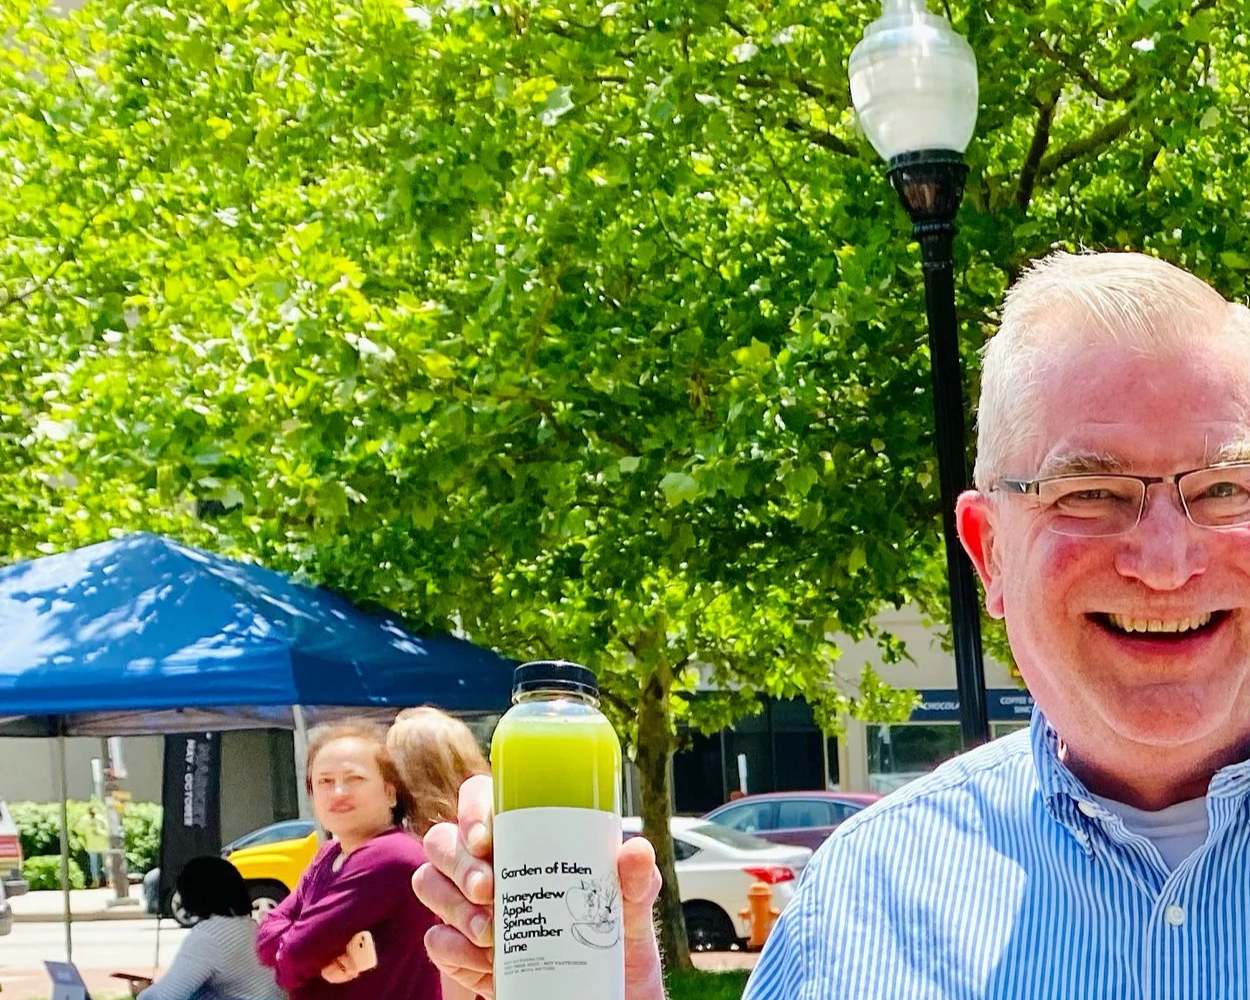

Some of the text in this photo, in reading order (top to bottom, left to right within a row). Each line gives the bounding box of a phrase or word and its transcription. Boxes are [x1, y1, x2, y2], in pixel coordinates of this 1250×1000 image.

[501, 862, 592, 879] Garden of Eden
[502, 887, 565, 905] Honeydew
[503, 902, 533, 919] Apple
[503, 912, 547, 932] Spinach
[503, 925, 563, 942] Cucumber
[503, 941, 528, 954] Lime
